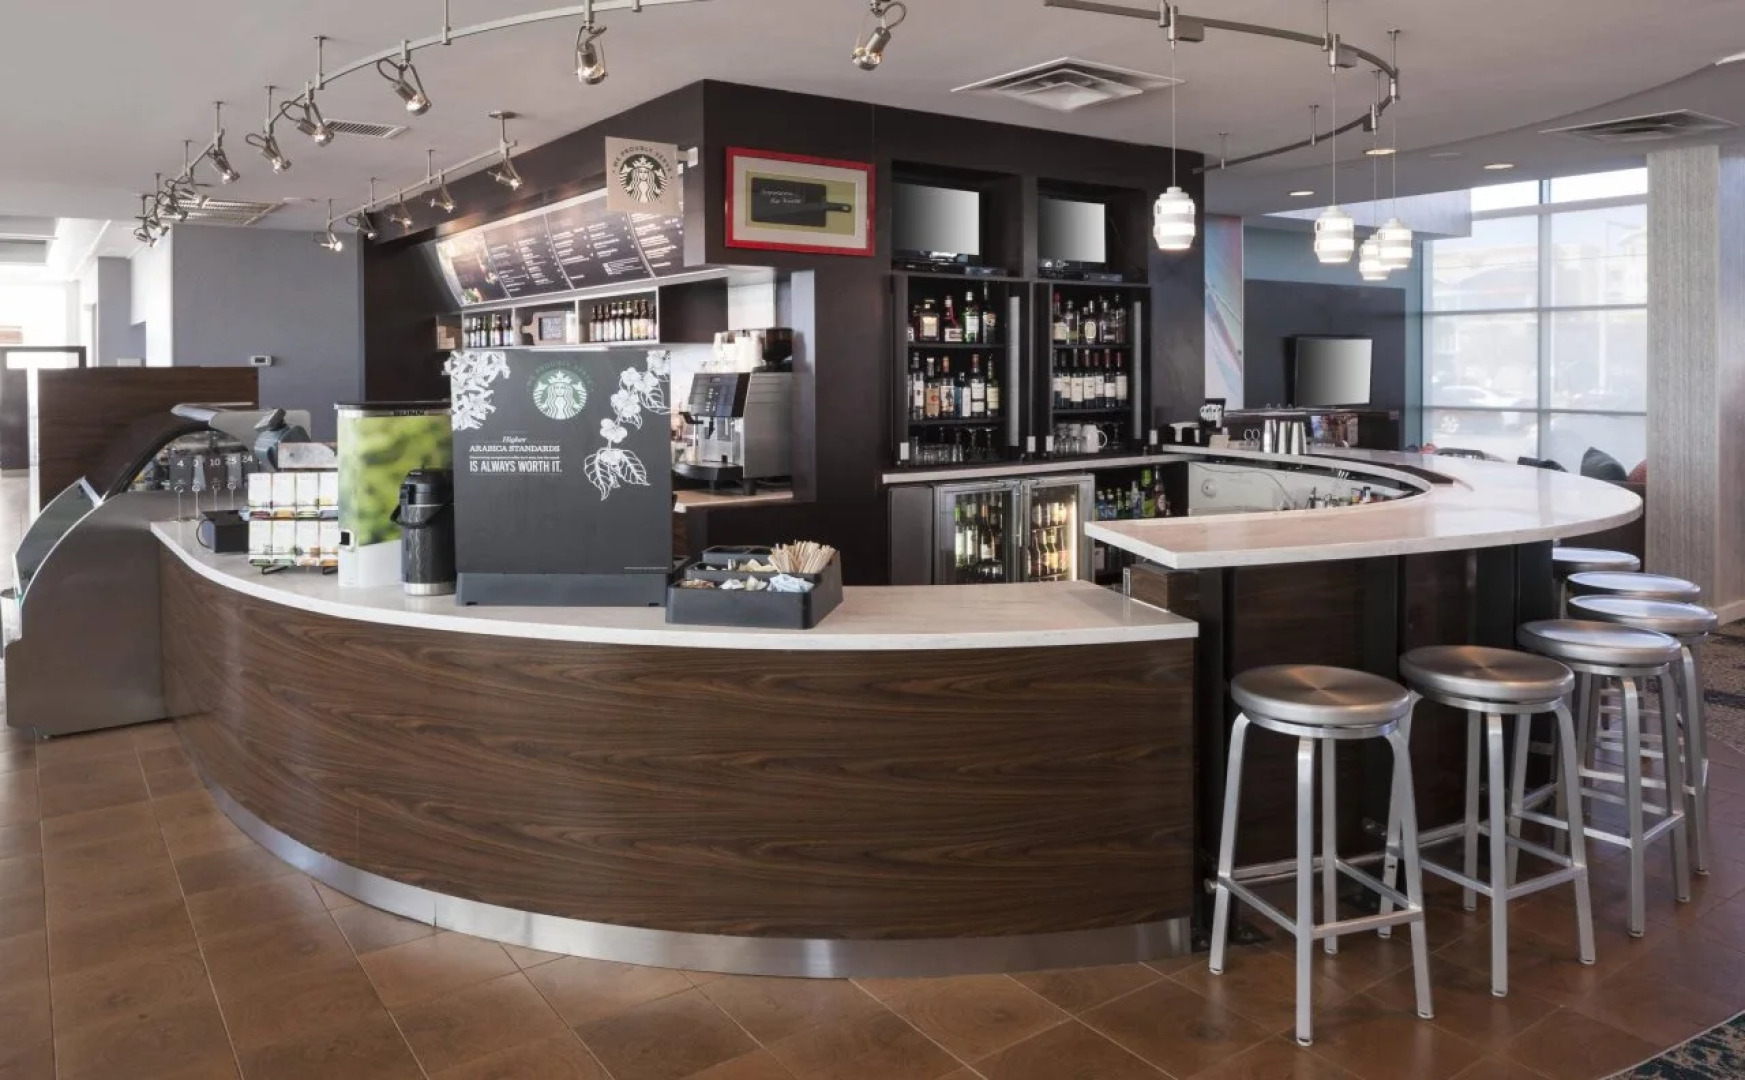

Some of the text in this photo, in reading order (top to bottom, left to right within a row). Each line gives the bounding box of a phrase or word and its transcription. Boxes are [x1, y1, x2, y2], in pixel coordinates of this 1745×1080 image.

[619, 145, 653, 157] PROUDLY
[655, 152, 673, 172] SERVE
[469, 460, 563, 473] IS ALWAYS WORTH IT.
